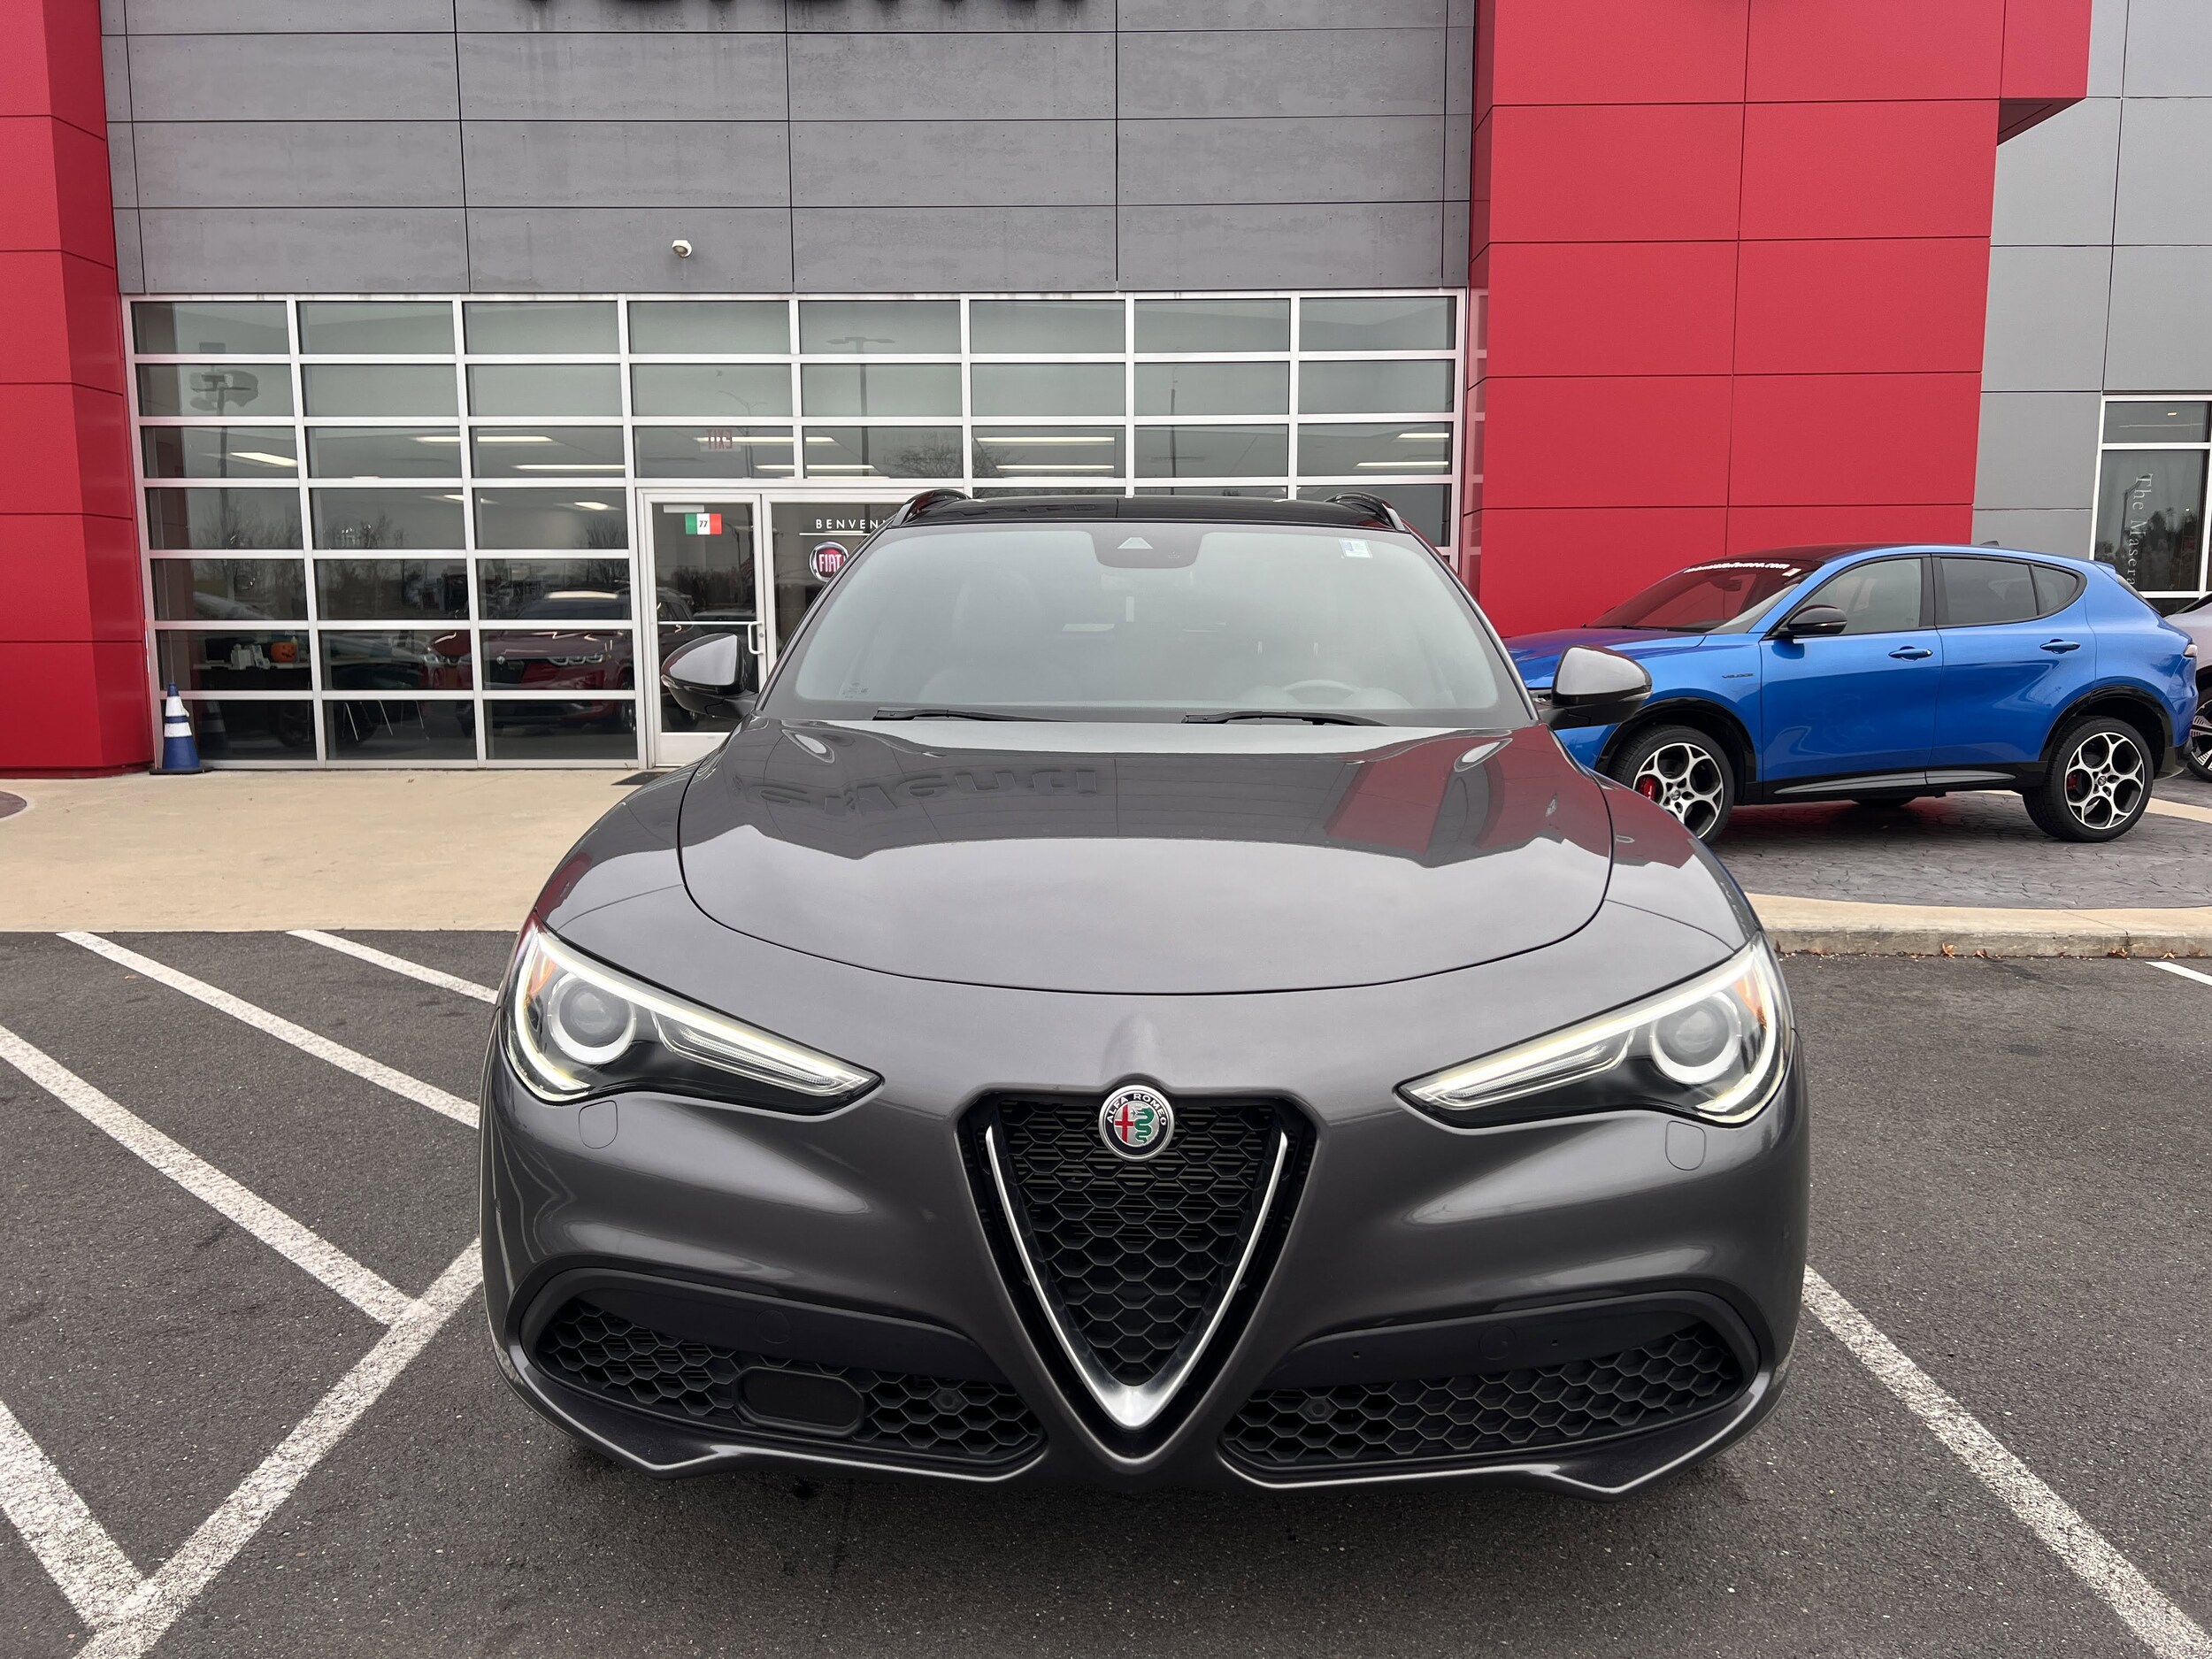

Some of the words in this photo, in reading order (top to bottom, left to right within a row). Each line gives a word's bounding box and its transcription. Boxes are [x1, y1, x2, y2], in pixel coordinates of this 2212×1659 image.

[2133, 472, 2154, 511] The
[698, 519, 709, 528] 77
[815, 518, 886, 530] BENVEN
[818, 553, 842, 572] FIAT
[1106, 1096, 1129, 1124] ALFA
[1133, 1093, 1167, 1126] ROMEO
